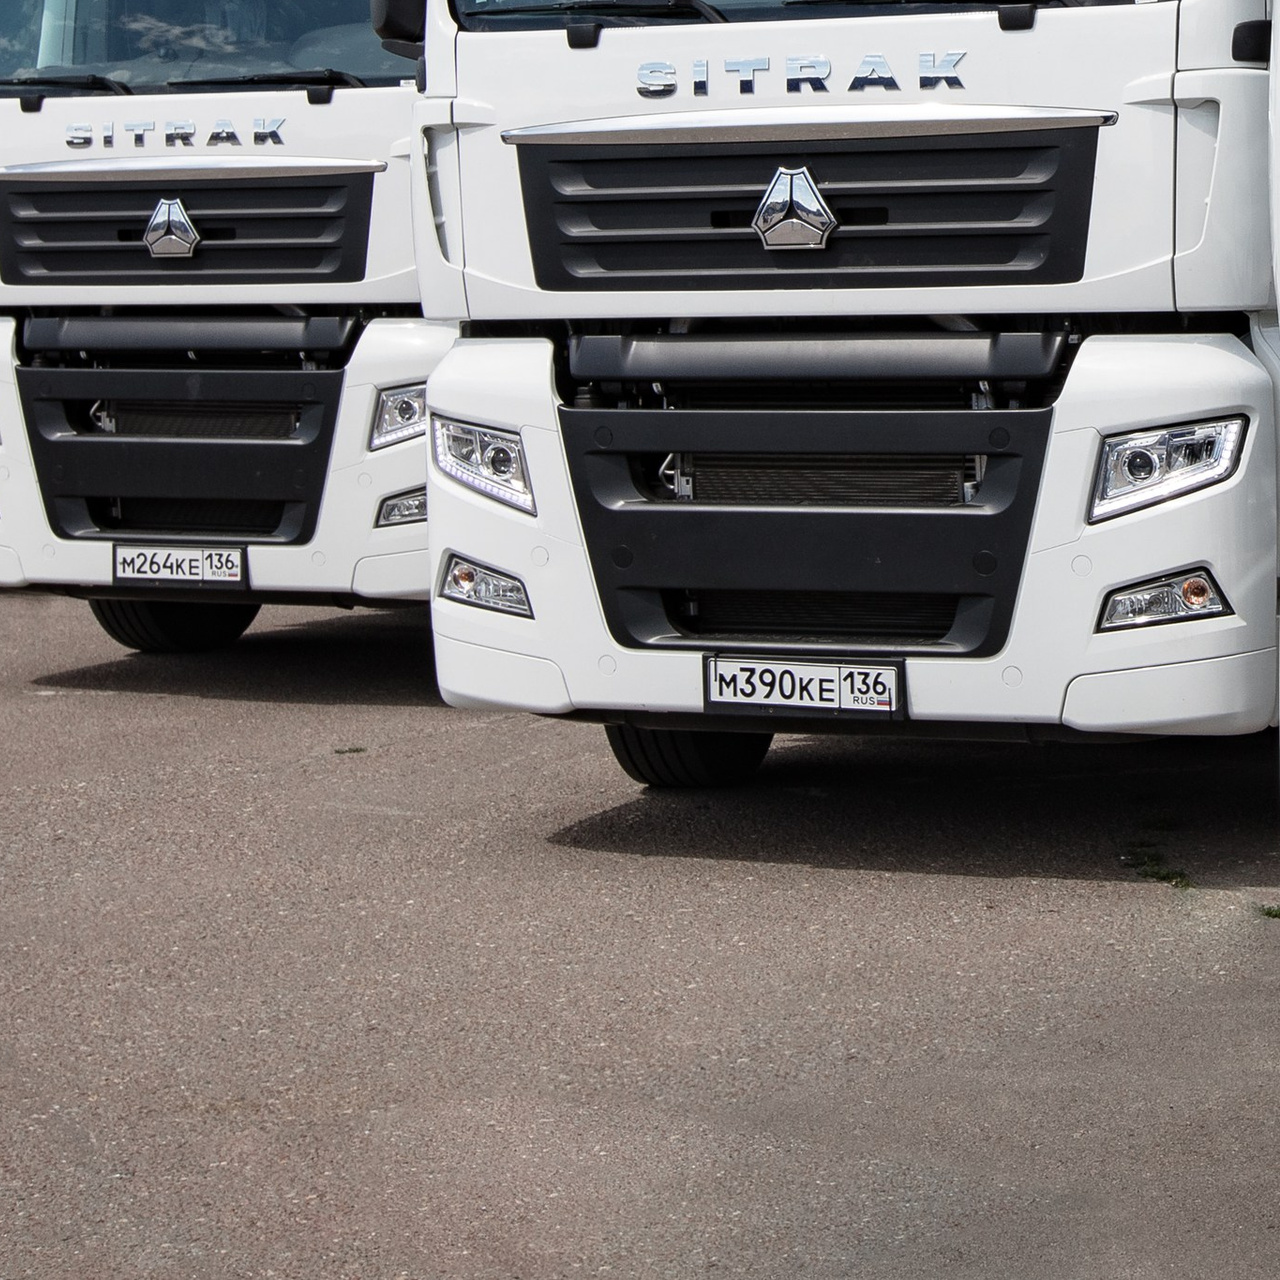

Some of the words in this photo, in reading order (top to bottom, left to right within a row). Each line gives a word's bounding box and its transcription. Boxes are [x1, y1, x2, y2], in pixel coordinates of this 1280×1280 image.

[636, 51, 968, 100] SITRAK
[65, 118, 287, 150] SITRAK
[204, 552, 235, 570] 136
[842, 671, 887, 696] 136
[852, 696, 875, 706] RUS
